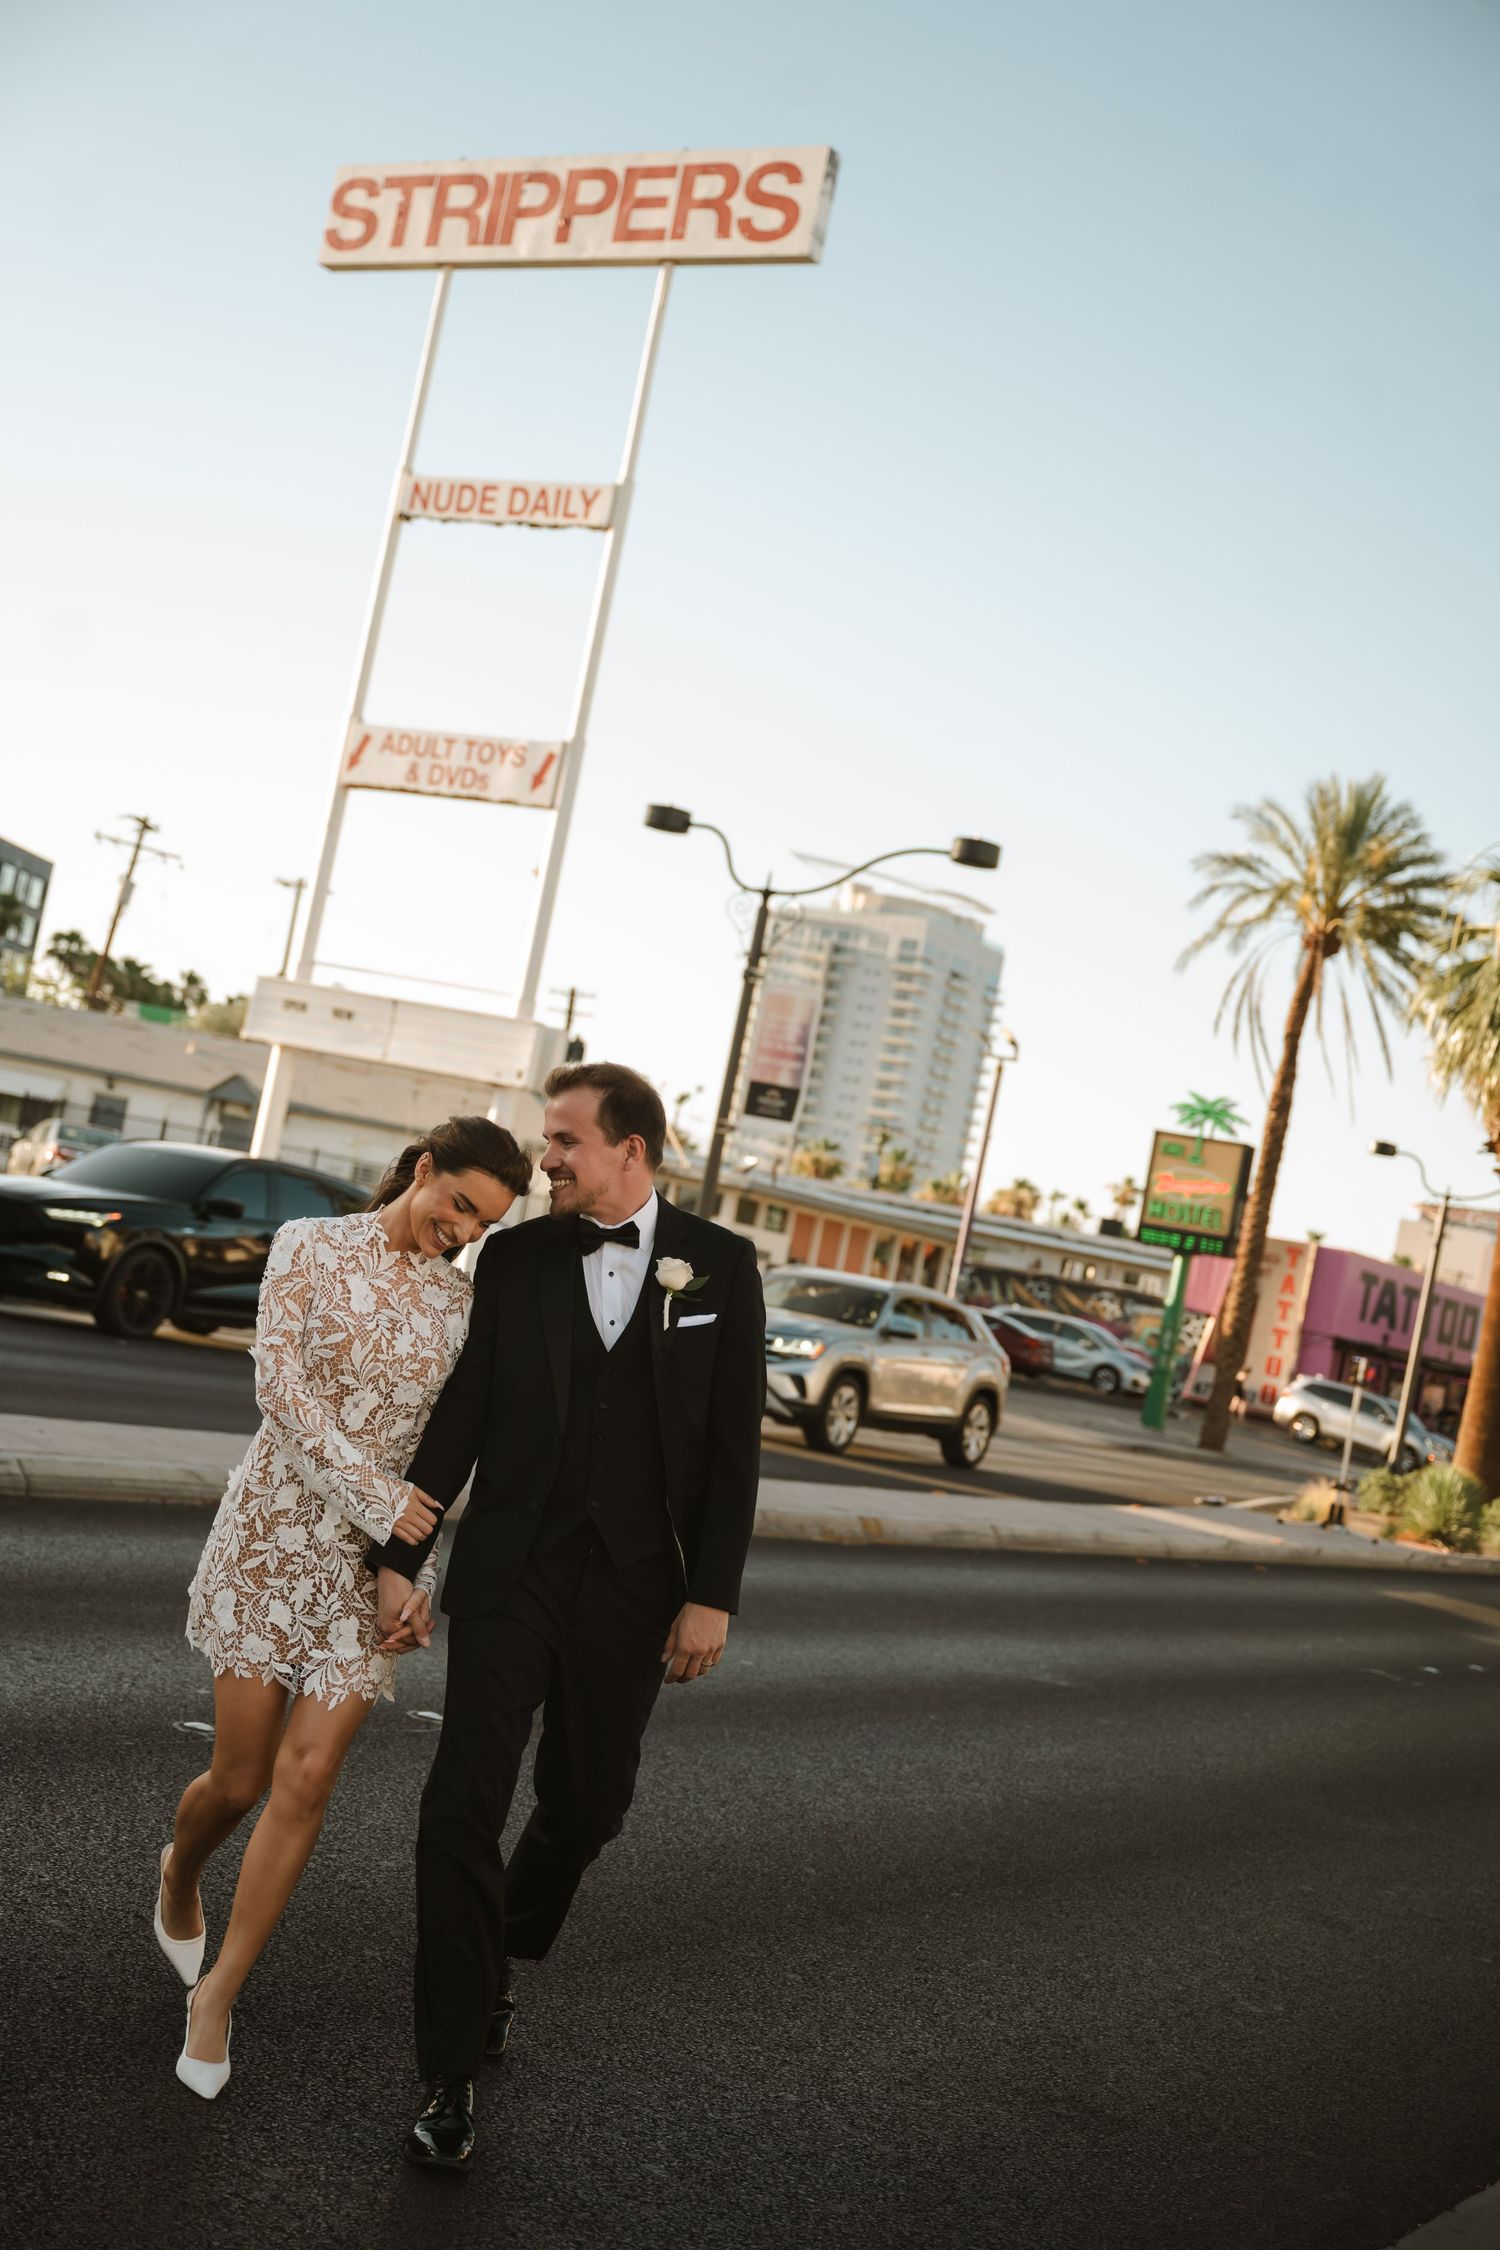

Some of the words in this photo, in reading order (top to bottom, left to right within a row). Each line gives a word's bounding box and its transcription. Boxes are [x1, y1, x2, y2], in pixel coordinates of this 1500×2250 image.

[324, 161, 805, 252] STRIPPERS
[409, 481, 499, 515] NUDE
[507, 486, 601, 519] DAILY
[379, 732, 458, 760] ADULT
[465, 739, 529, 768] TOYS
[405, 762, 420, 784] &
[427, 764, 492, 791] DVDs
[1148, 1199, 1224, 1230] HOSTEL
[1259, 1246, 1305, 1404] TATTOO
